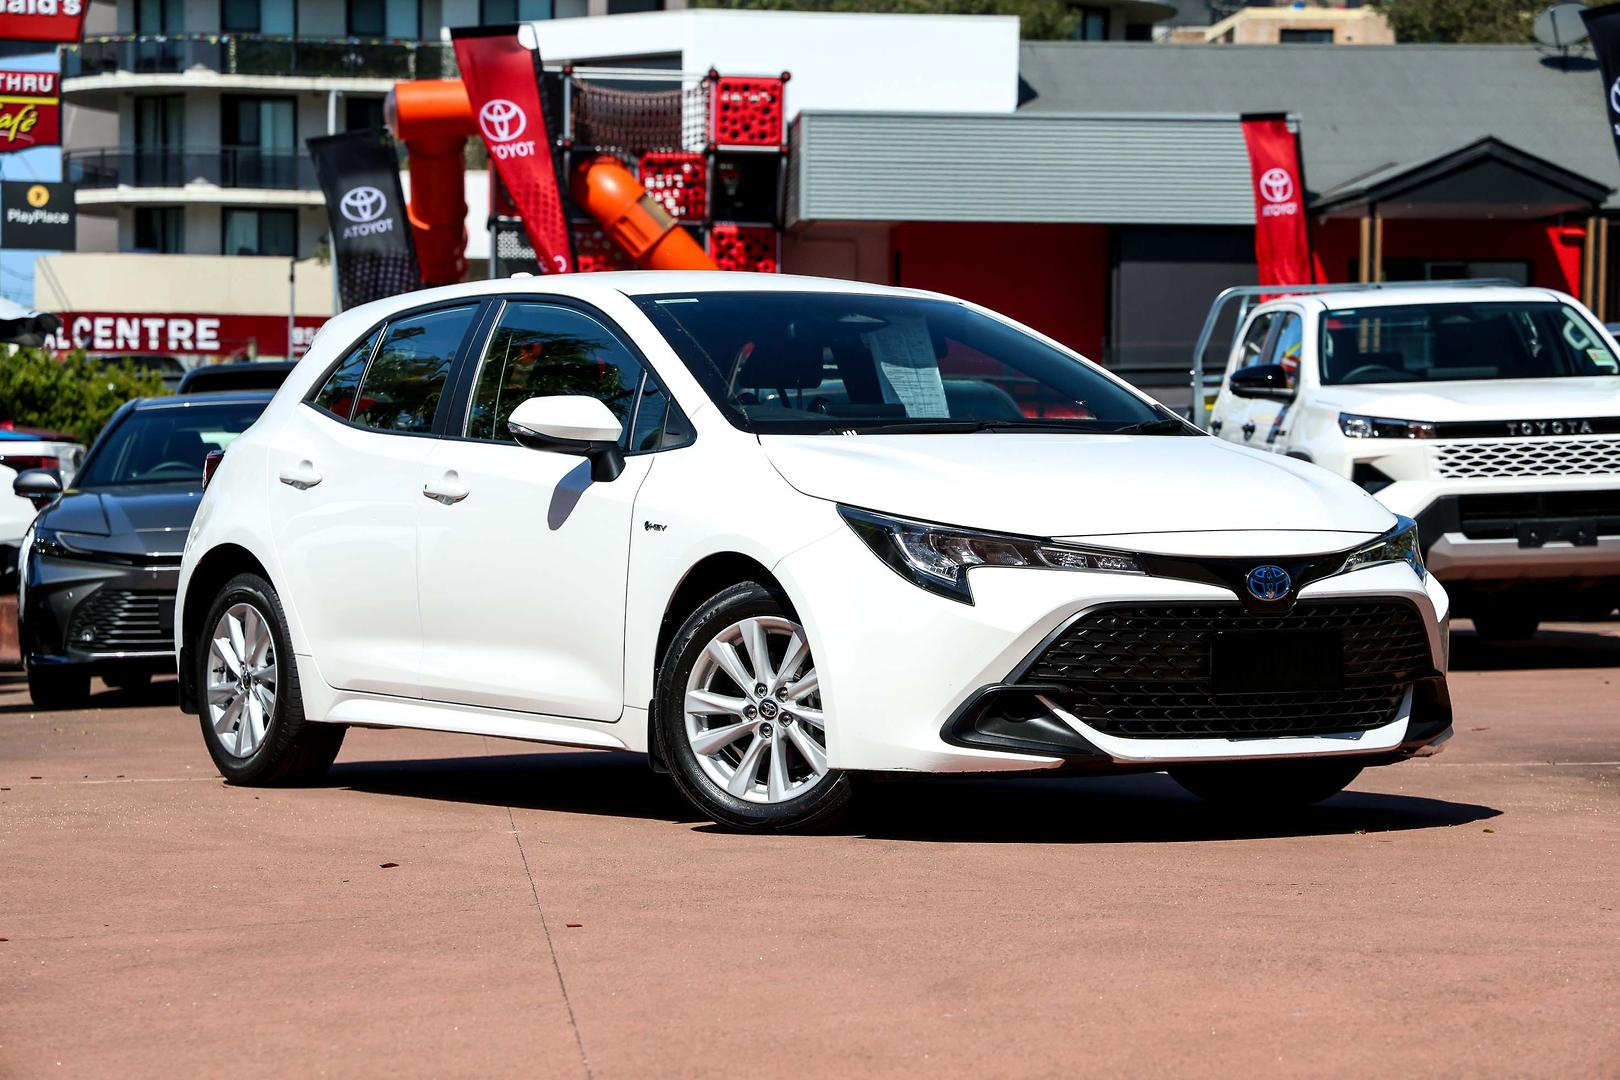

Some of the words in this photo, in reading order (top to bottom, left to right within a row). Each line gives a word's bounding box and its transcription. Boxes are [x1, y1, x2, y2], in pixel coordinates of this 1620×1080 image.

[7, 208, 69, 225] PlayPlace
[72, 316, 221, 350] CENTRE
[1507, 420, 1593, 436] TOYOTA
